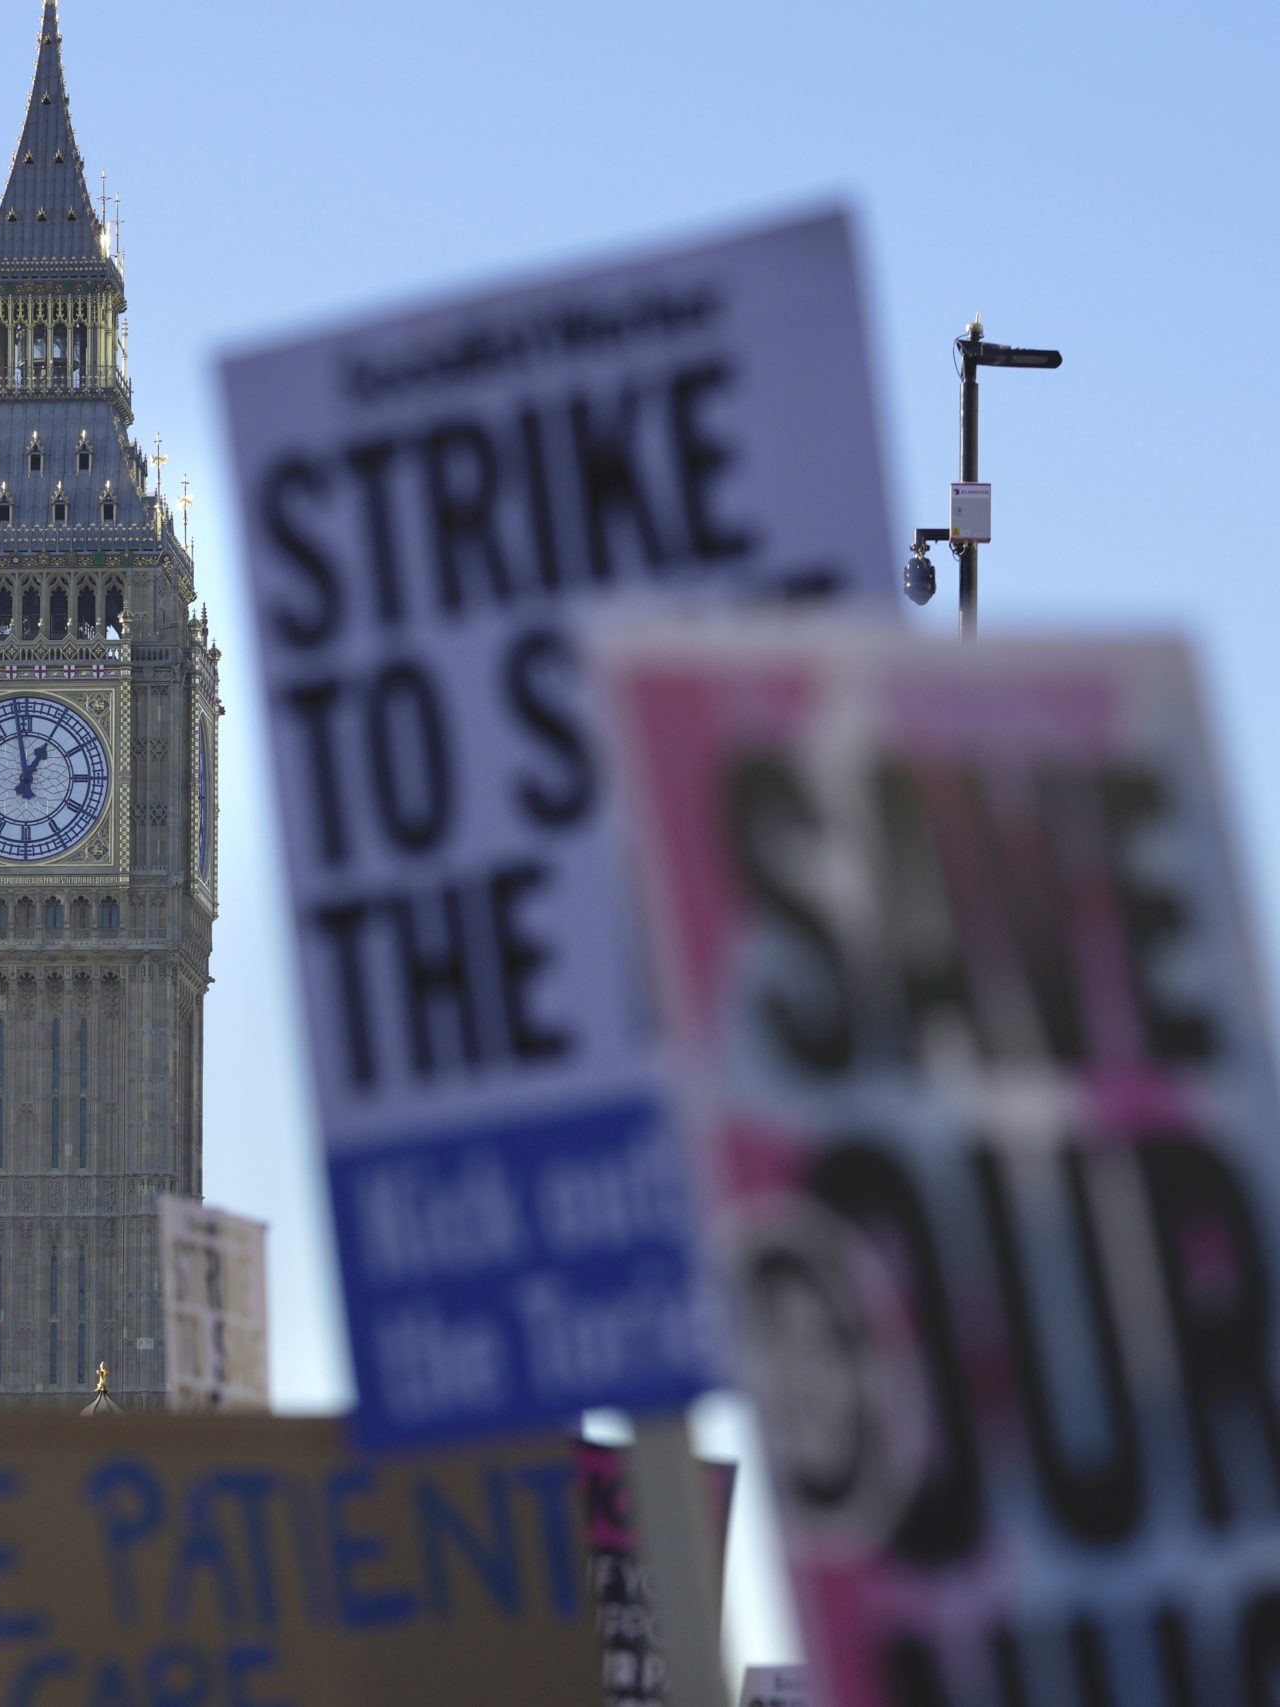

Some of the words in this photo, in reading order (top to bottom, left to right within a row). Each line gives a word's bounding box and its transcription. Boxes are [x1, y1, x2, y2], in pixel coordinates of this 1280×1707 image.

[256, 361, 758, 650] STRIKE
[288, 658, 452, 866] TO
[317, 862, 570, 1095] THE
[720, 748, 1215, 1082] SAVE
[83, 1455, 578, 1632] PATIENT
